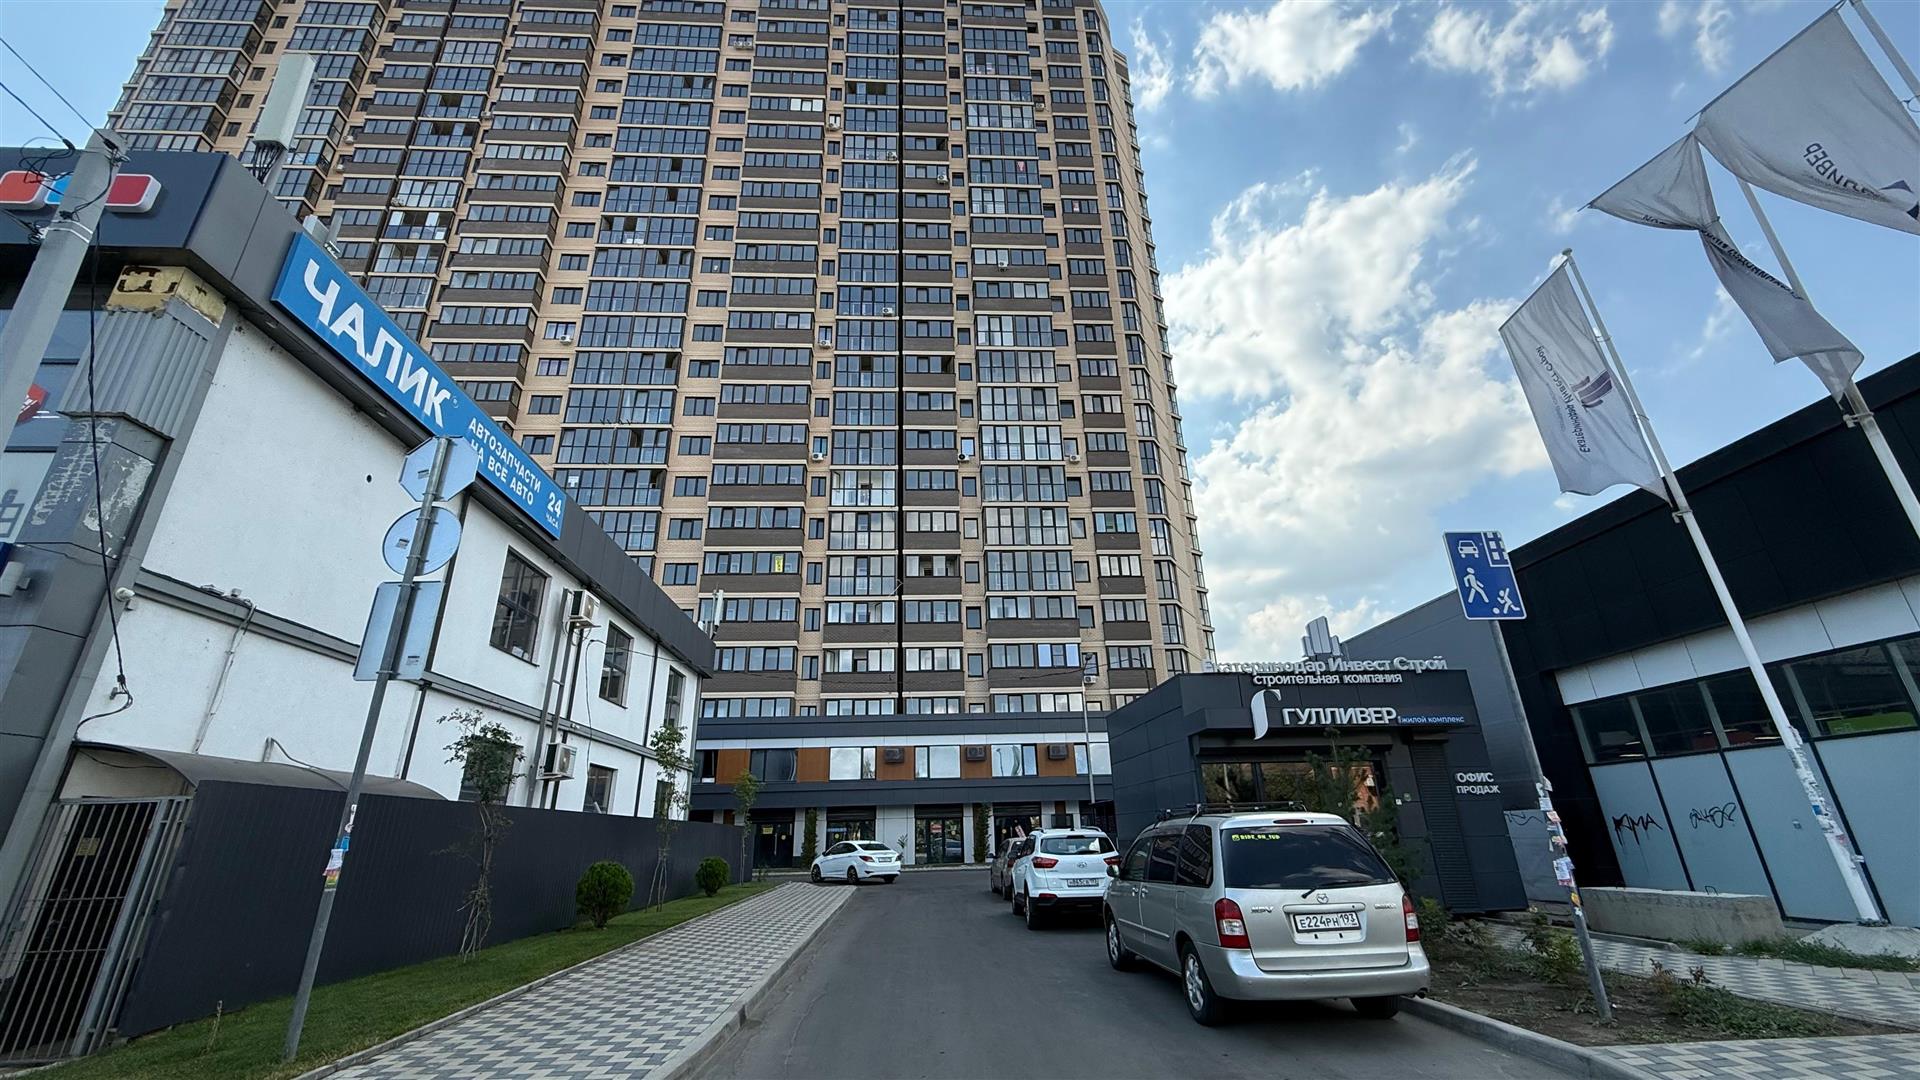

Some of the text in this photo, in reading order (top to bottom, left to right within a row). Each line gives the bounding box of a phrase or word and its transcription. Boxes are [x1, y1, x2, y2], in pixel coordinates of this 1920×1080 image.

[303, 258, 451, 428] ЧАЛИК
[468, 417, 541, 493] АВТОЗАПЧАСТИ
[487, 455, 509, 483] ВСЕ
[510, 477, 534, 505] АВТО
[547, 491, 562, 517] 24
[1327, 657, 1391, 672] Инвест
[1393, 656, 1448, 673] Строй
[1253, 673, 1403, 687] строительная компания
[1282, 707, 1397, 725] ГУЛЛИВЕР
[1455, 772, 1495, 783] ОФИС
[1456, 785, 1501, 794] ПРОДАЖ
[1299, 913, 1356, 929] Е224РН 193
